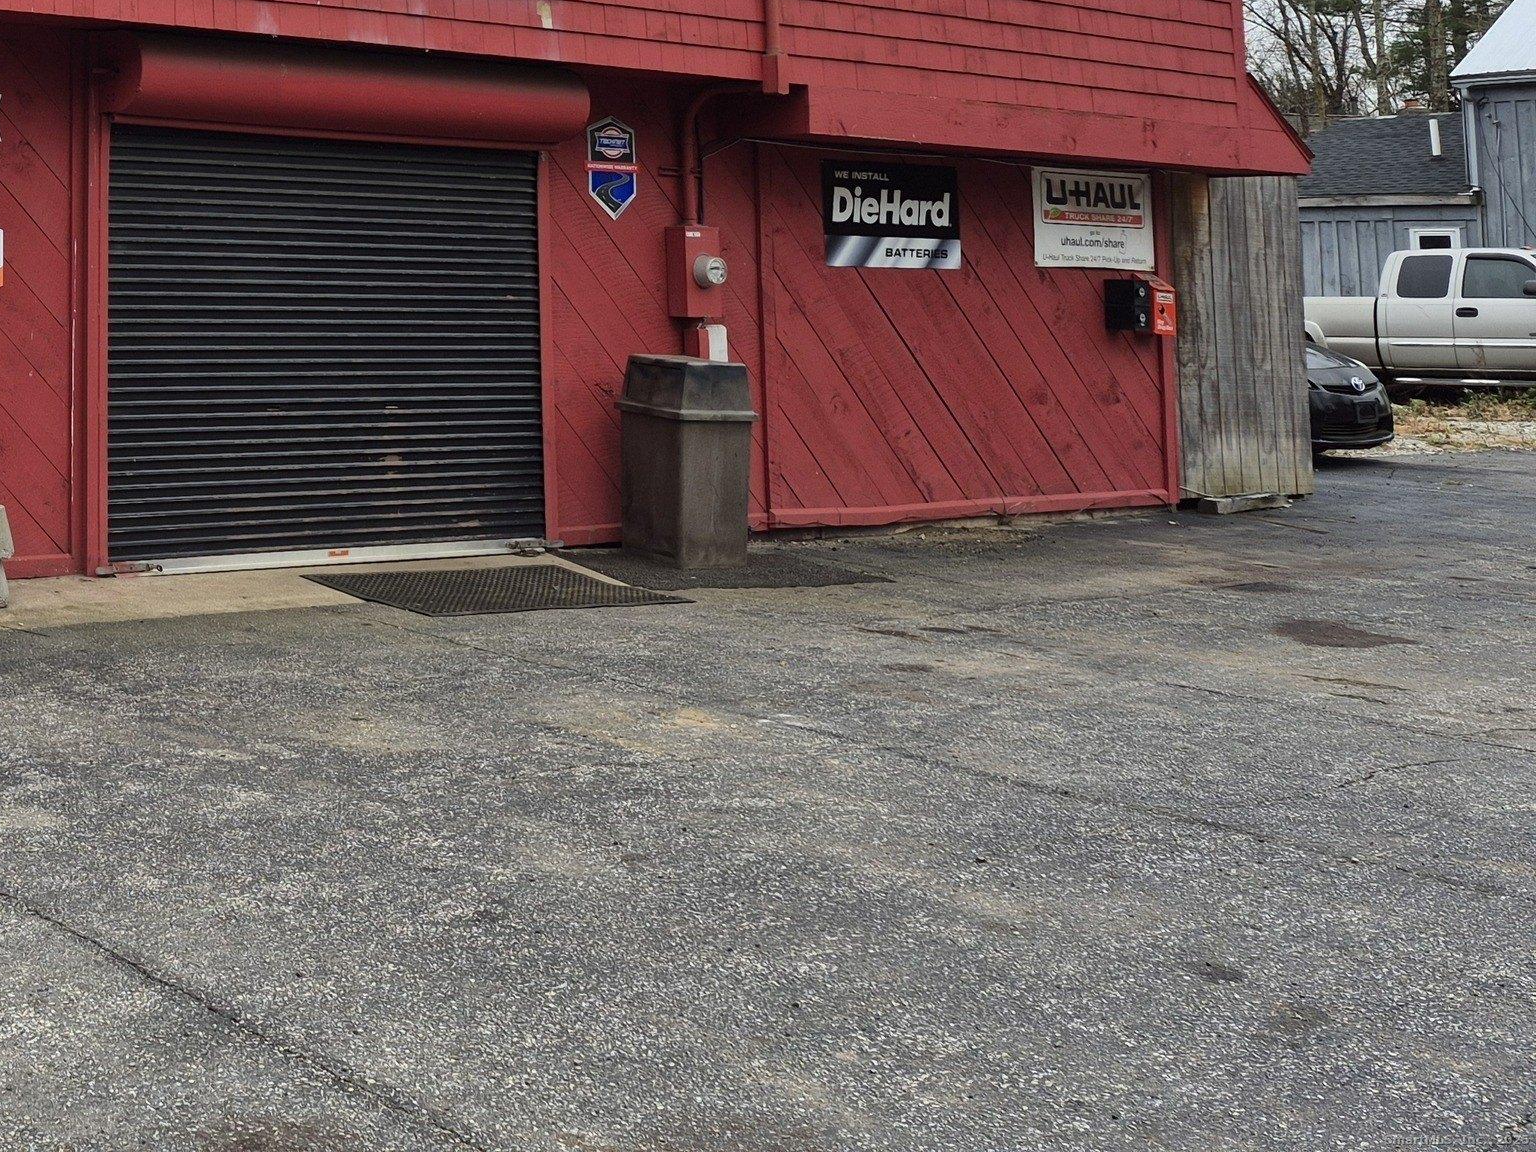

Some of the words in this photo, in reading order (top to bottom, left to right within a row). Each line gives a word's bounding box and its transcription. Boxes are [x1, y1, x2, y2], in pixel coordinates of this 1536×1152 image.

[834, 170, 849, 179] WE
[851, 171, 889, 181] INSTALL
[1045, 178, 1141, 210] U-HAUL
[832, 186, 951, 228] DieHard
[1064, 212, 1090, 221] TRUCK
[1091, 214, 1115, 223] SHARE
[1117, 214, 1133, 223] 24/7
[1061, 236, 1125, 249] uhaul.com/share
[885, 247, 949, 259] BATTERIES
